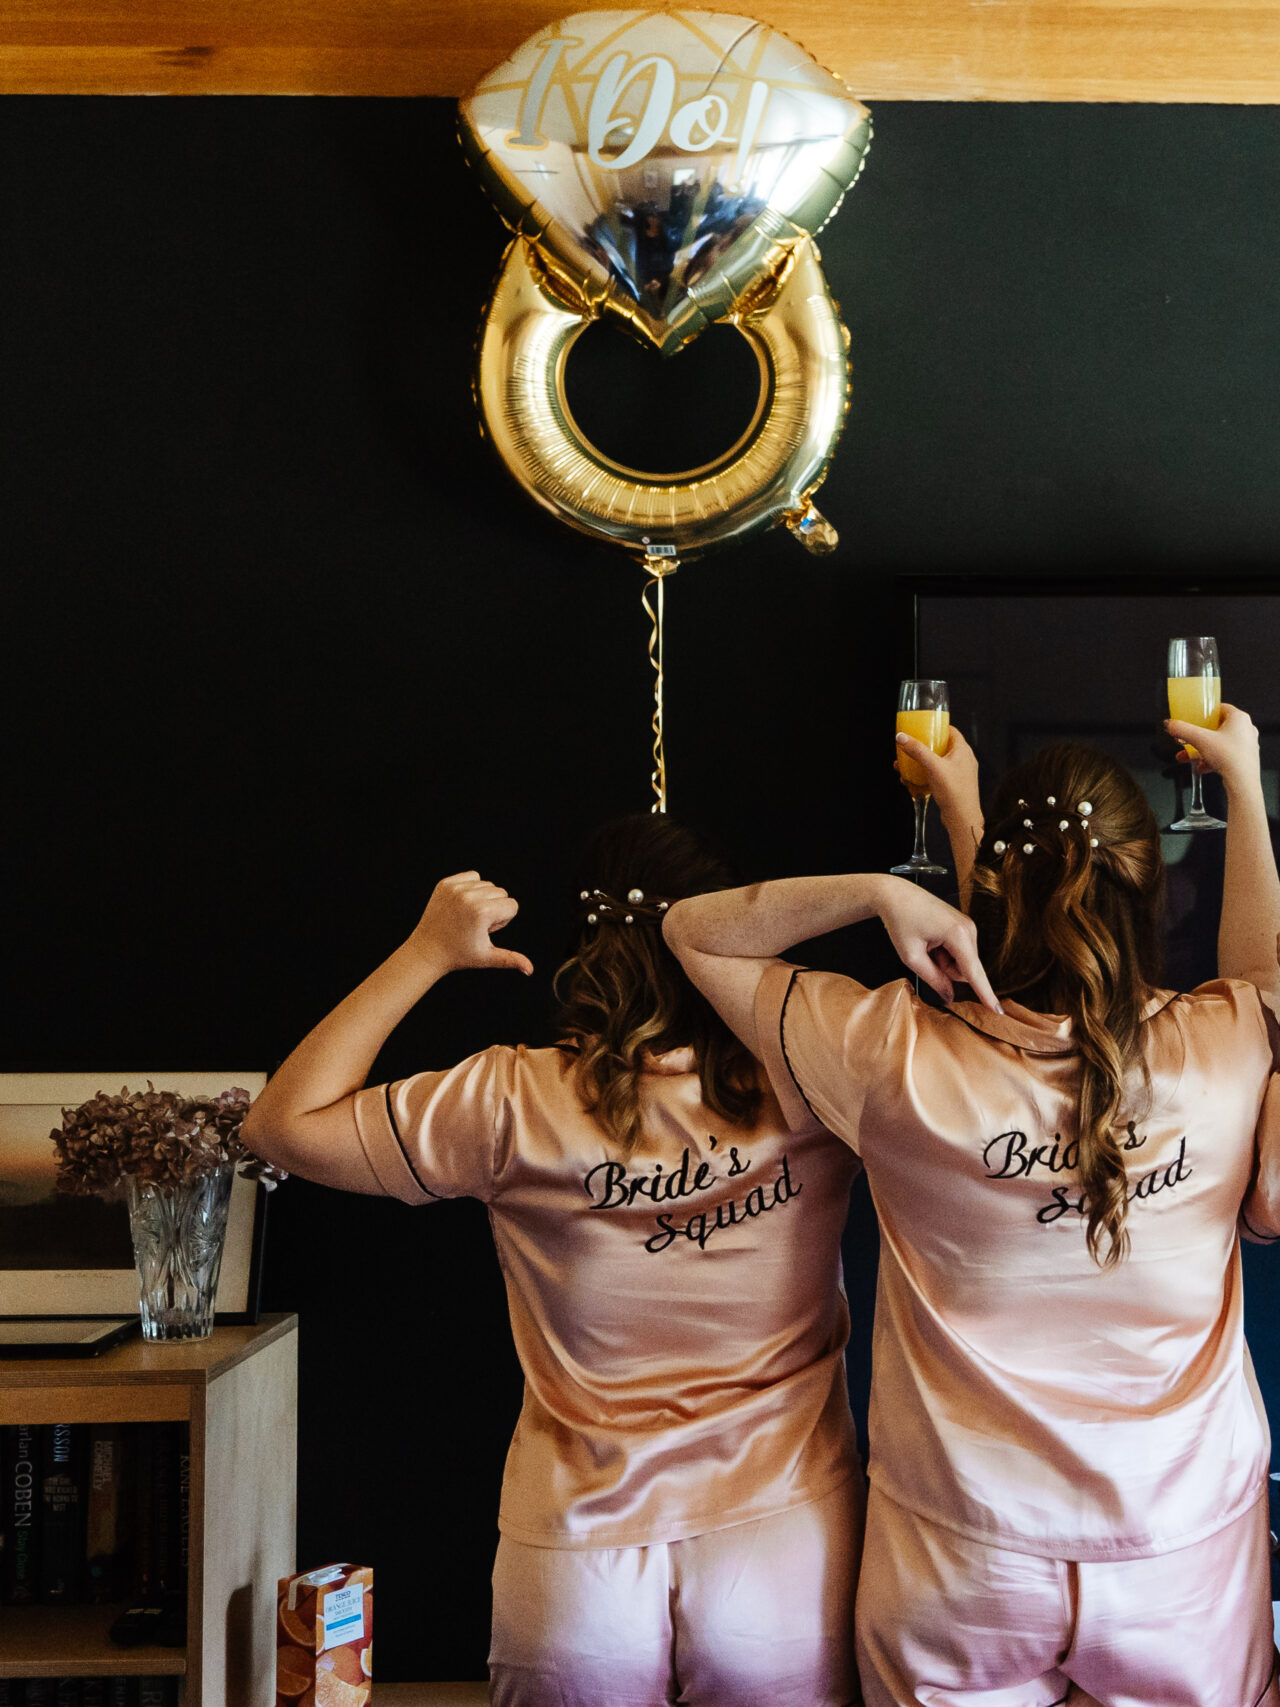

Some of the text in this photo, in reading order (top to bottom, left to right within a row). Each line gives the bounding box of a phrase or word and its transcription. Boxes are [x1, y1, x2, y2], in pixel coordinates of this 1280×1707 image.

[507, 37, 582, 149] I
[584, 1135, 751, 1210] Bride's
[1037, 1136, 1193, 1224] Sad
[18, 1424, 32, 1458] arlan
[53, 1423, 71, 1462] RSSON
[103, 1440, 113, 1484] MICHAEL
[14, 1460, 32, 1527] COBEN
[335, 1590, 351, 1600] TESCO
